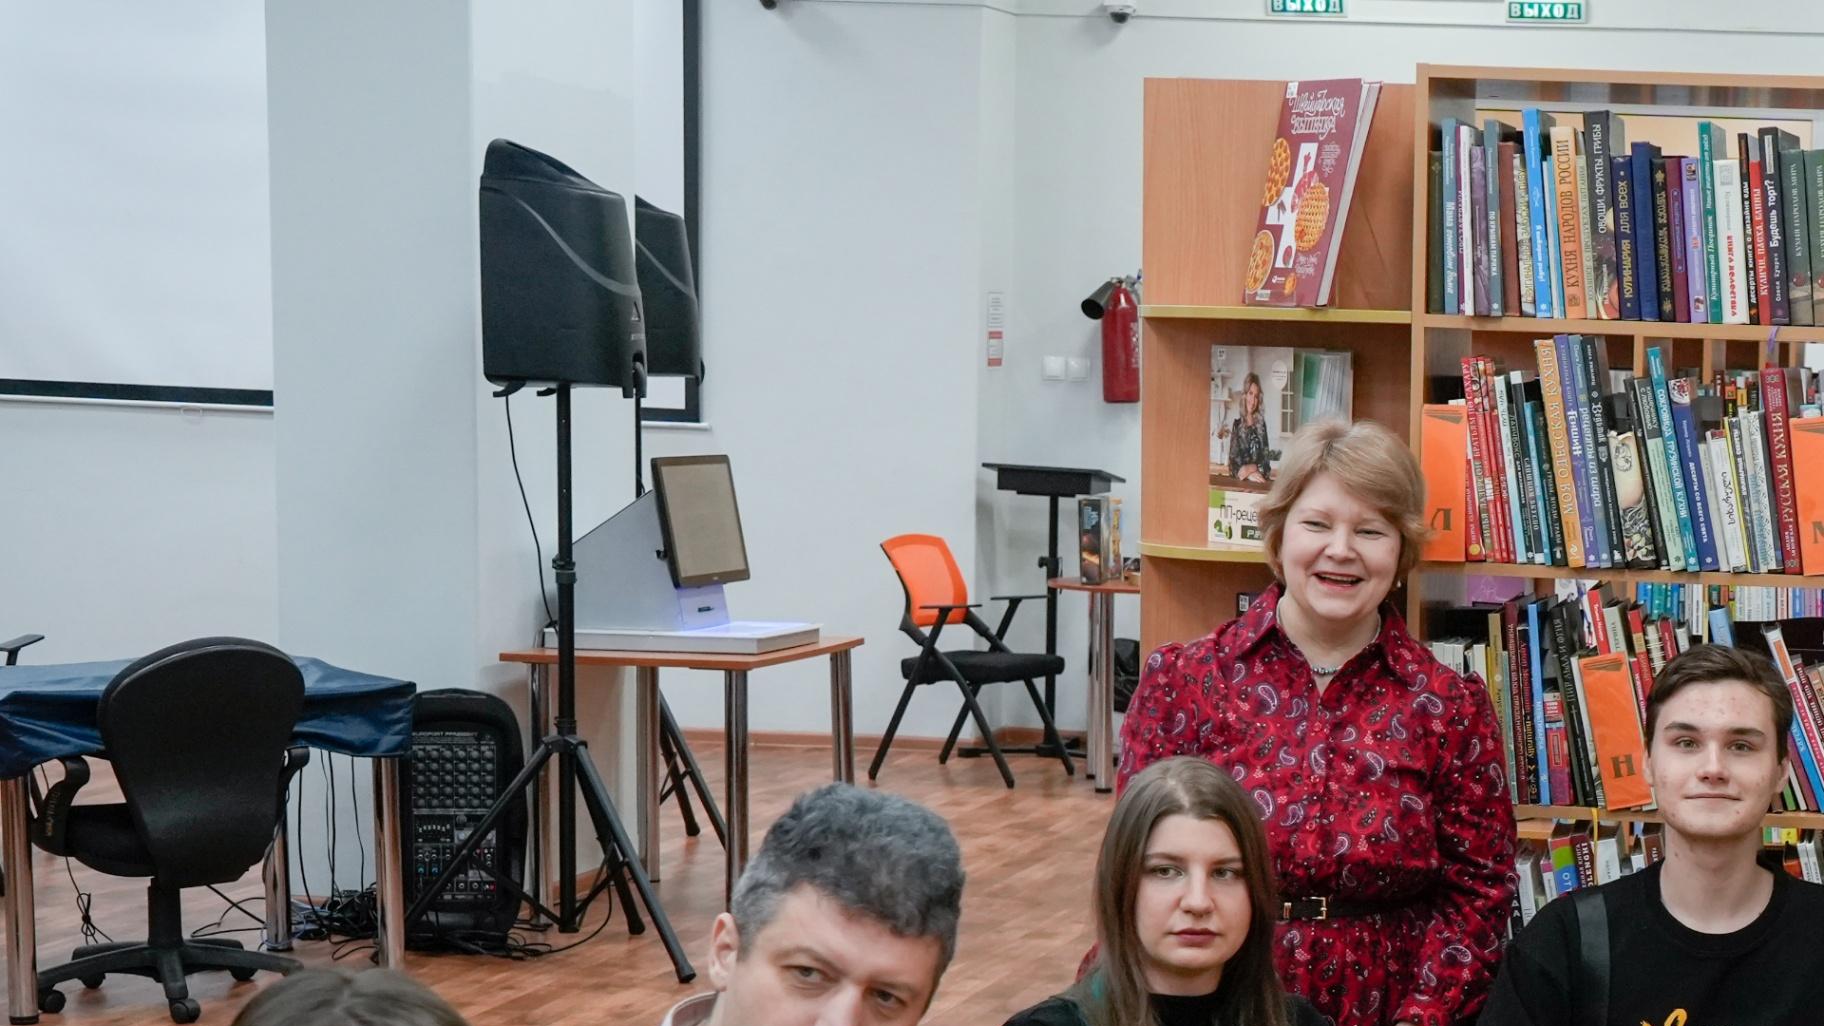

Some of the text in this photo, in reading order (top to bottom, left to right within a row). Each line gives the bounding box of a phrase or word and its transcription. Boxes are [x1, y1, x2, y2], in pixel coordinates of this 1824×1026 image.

[1510, 3, 1580, 19] ВЫХОД
[1556, 140, 1579, 287] КУХНЯ НАРОДОВ РОССИИ
[1622, 240, 1633, 297] КУЛИНАРИЯ
[1541, 347, 1575, 515] МОЯ ОДЕССКАЯ КУХНЯ
[1771, 412, 1794, 522] РУССКАЯ КУХНЯ
[1610, 753, 1635, 780] Н
